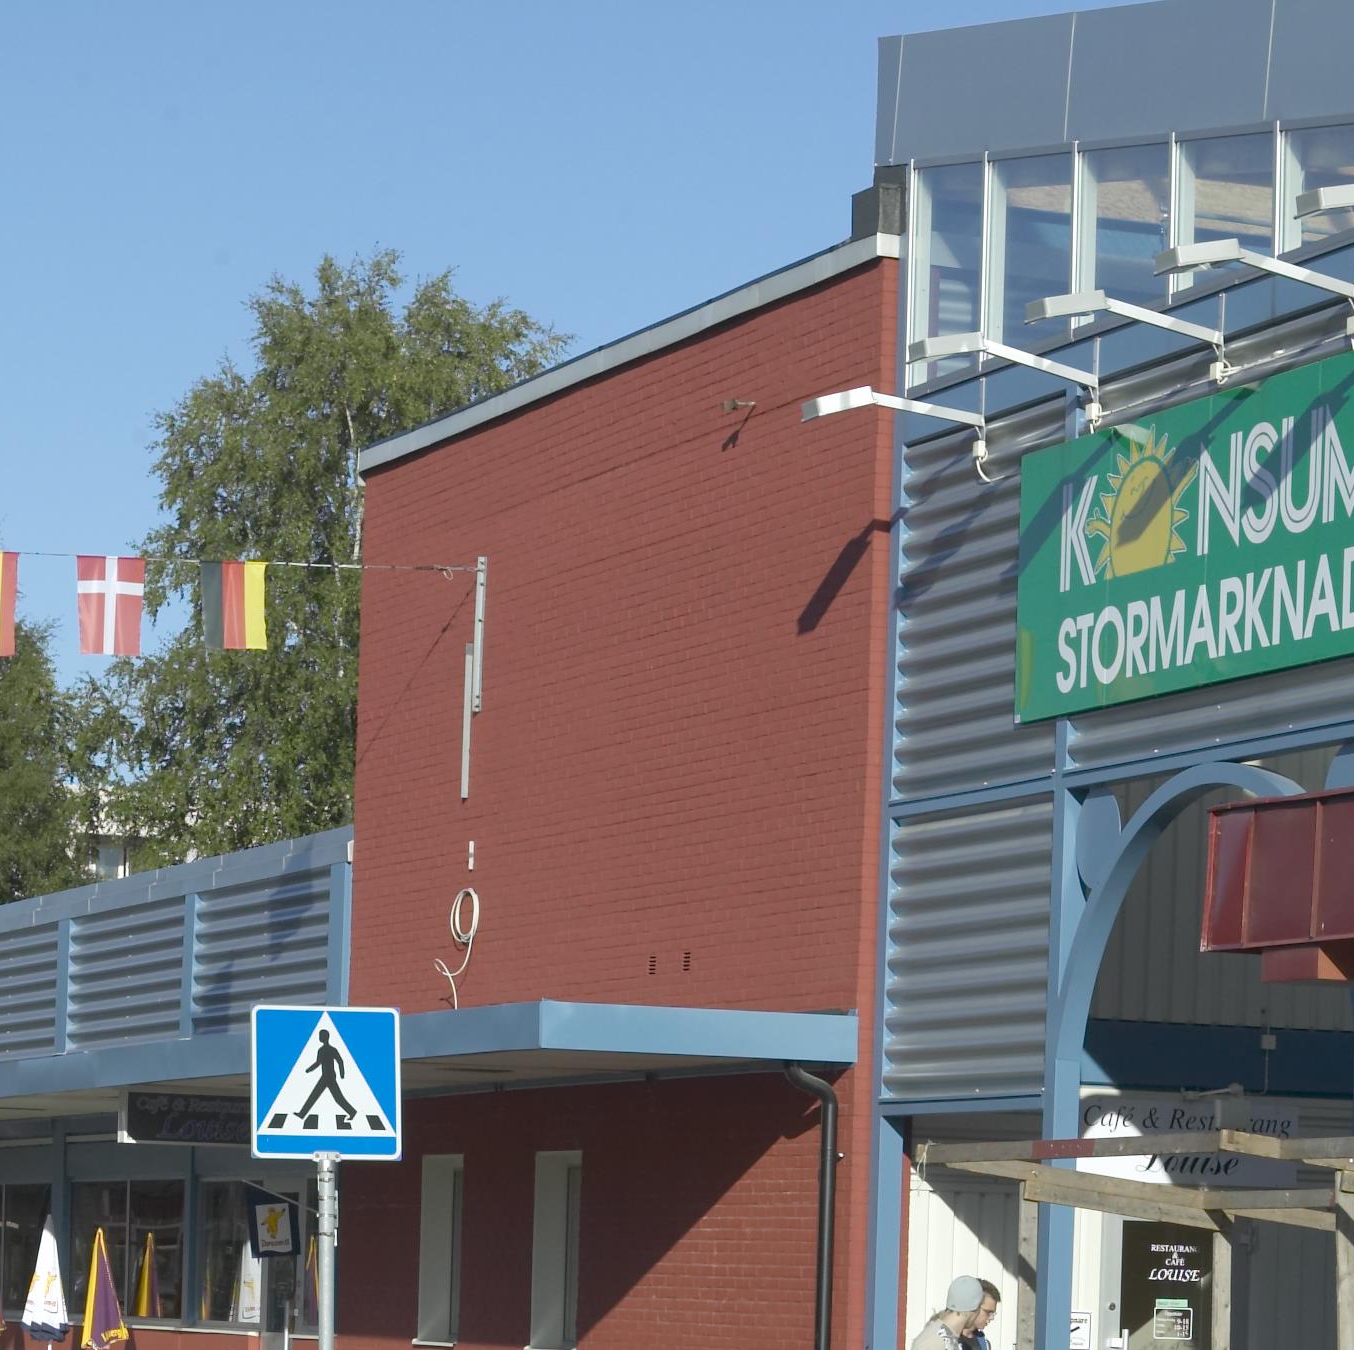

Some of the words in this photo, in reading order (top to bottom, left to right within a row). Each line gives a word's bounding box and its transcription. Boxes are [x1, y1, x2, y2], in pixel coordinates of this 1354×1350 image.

[1083, 1104, 1134, 1133] Café
[1142, 1107, 1160, 1129] &
[1169, 1108, 1292, 1139] Restang
[1148, 1268, 1201, 1283] LOUISE
